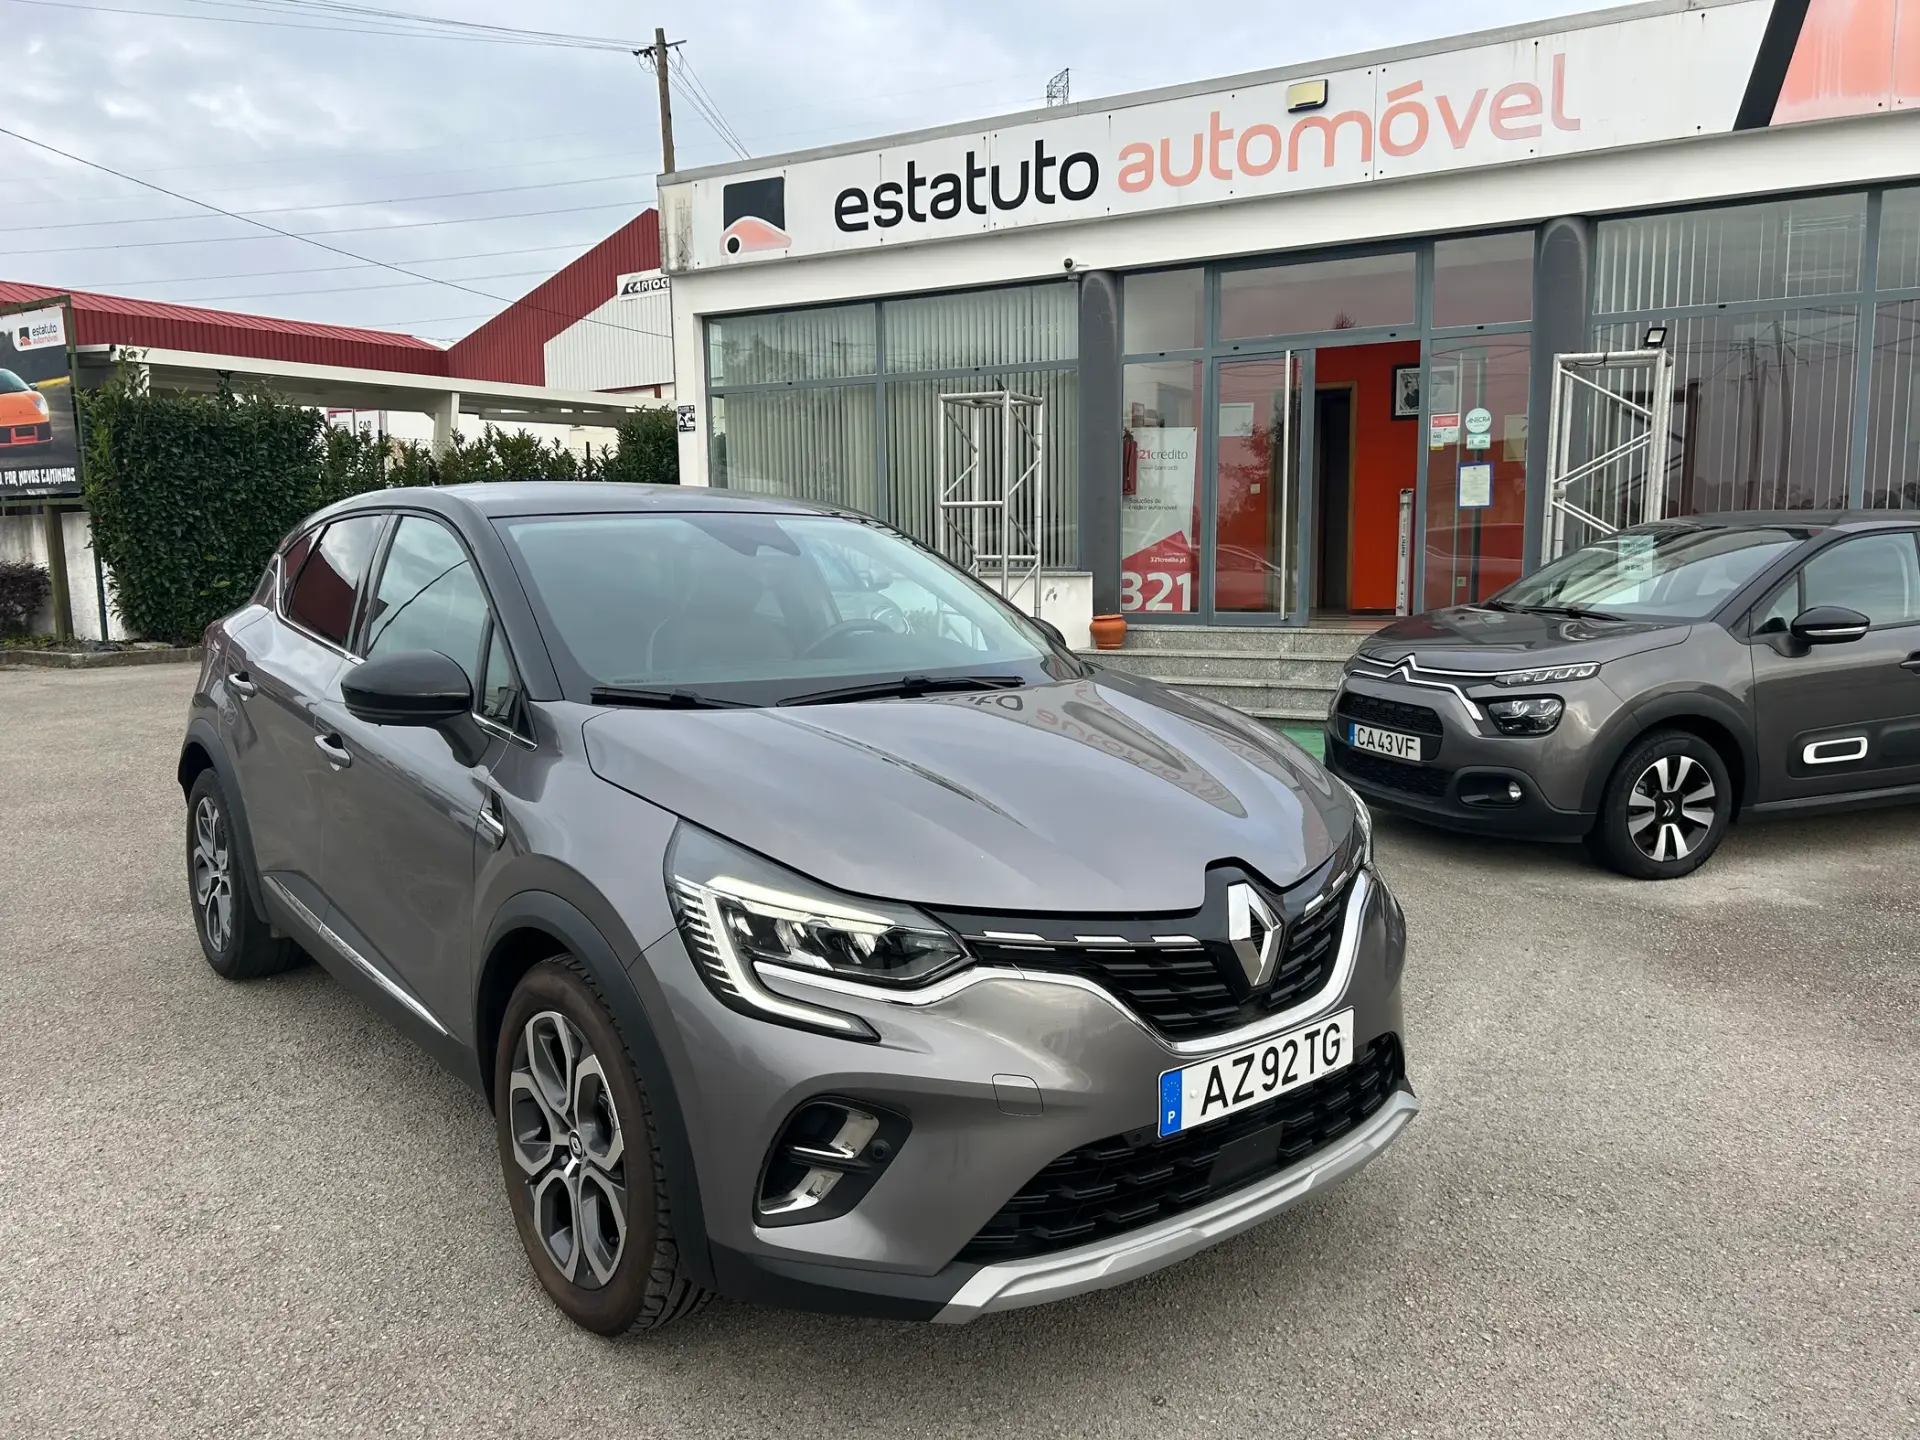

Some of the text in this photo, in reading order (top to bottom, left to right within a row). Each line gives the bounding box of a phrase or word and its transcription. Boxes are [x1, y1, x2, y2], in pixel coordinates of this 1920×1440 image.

[834, 53, 1581, 232] estatuto automóvel
[32, 322, 58, 336] estatuto
[1136, 449, 1189, 460] 21crédito
[1121, 571, 1191, 611] 321
[1167, 1111, 1176, 1124] P
